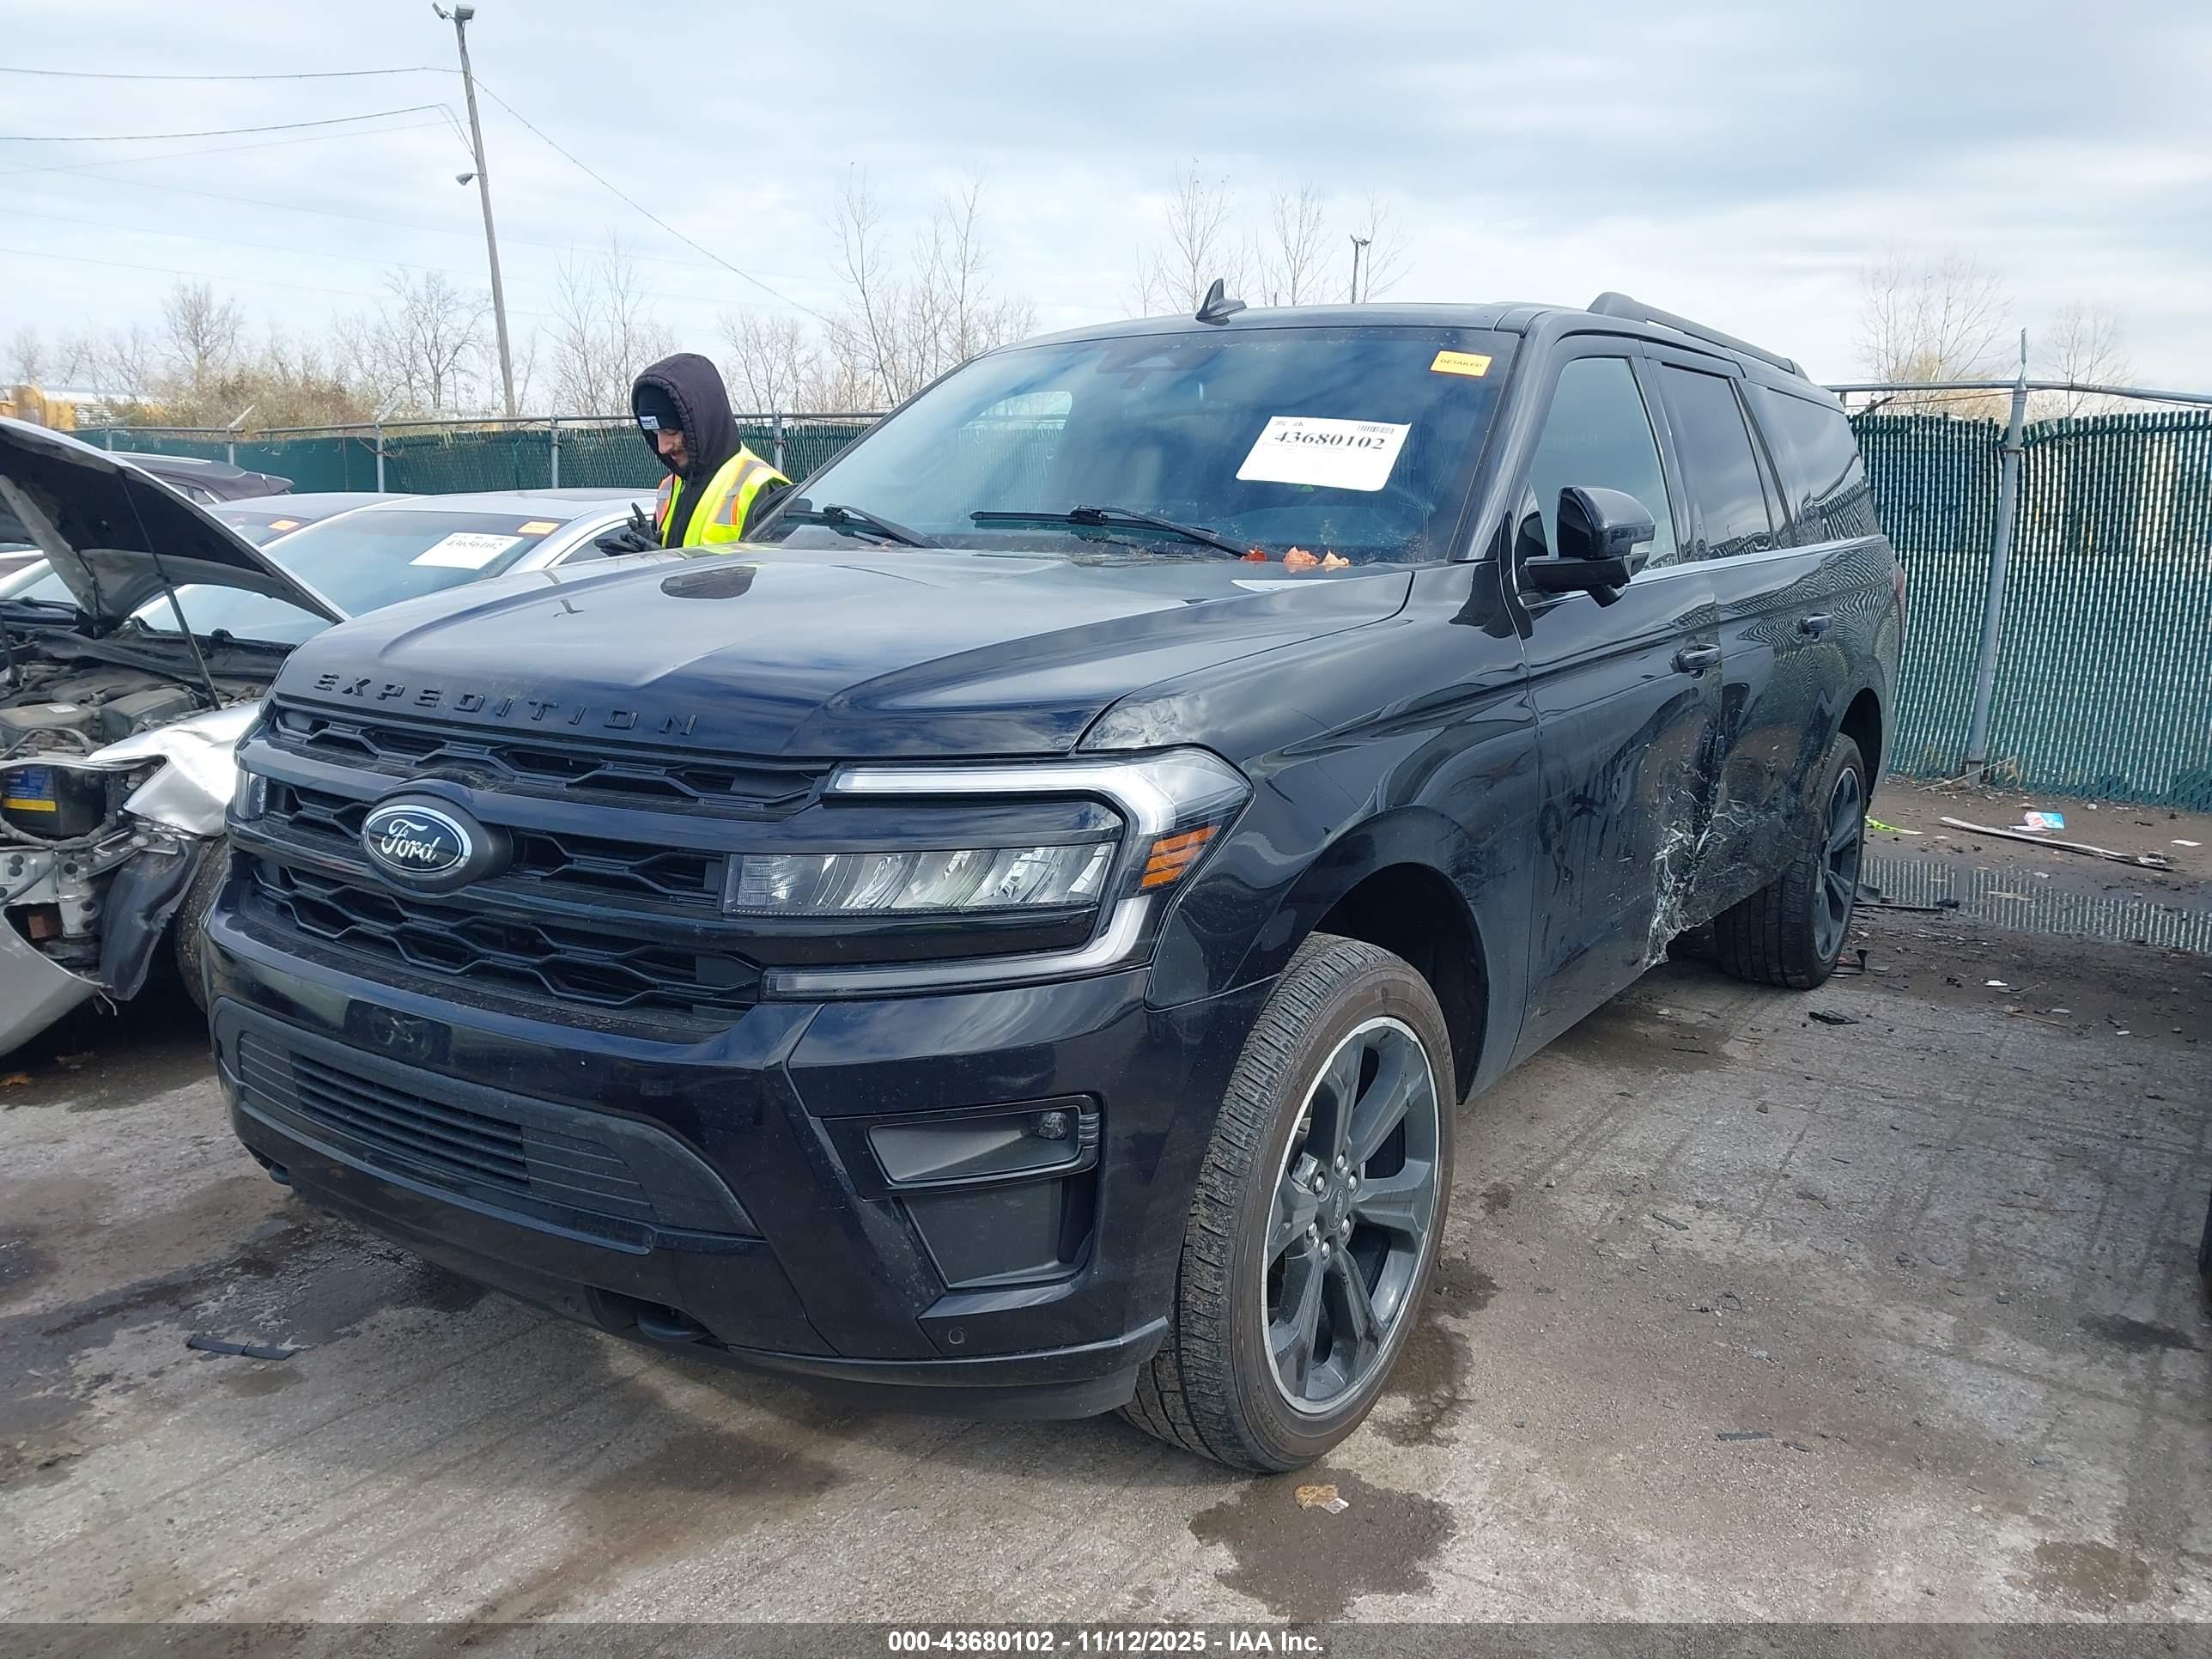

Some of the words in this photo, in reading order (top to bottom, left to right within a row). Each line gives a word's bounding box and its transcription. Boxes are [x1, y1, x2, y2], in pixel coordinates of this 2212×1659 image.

[1274, 431, 1385, 450] 43680102
[313, 673, 698, 736] EXPEDITION
[380, 818, 441, 864] Ford
